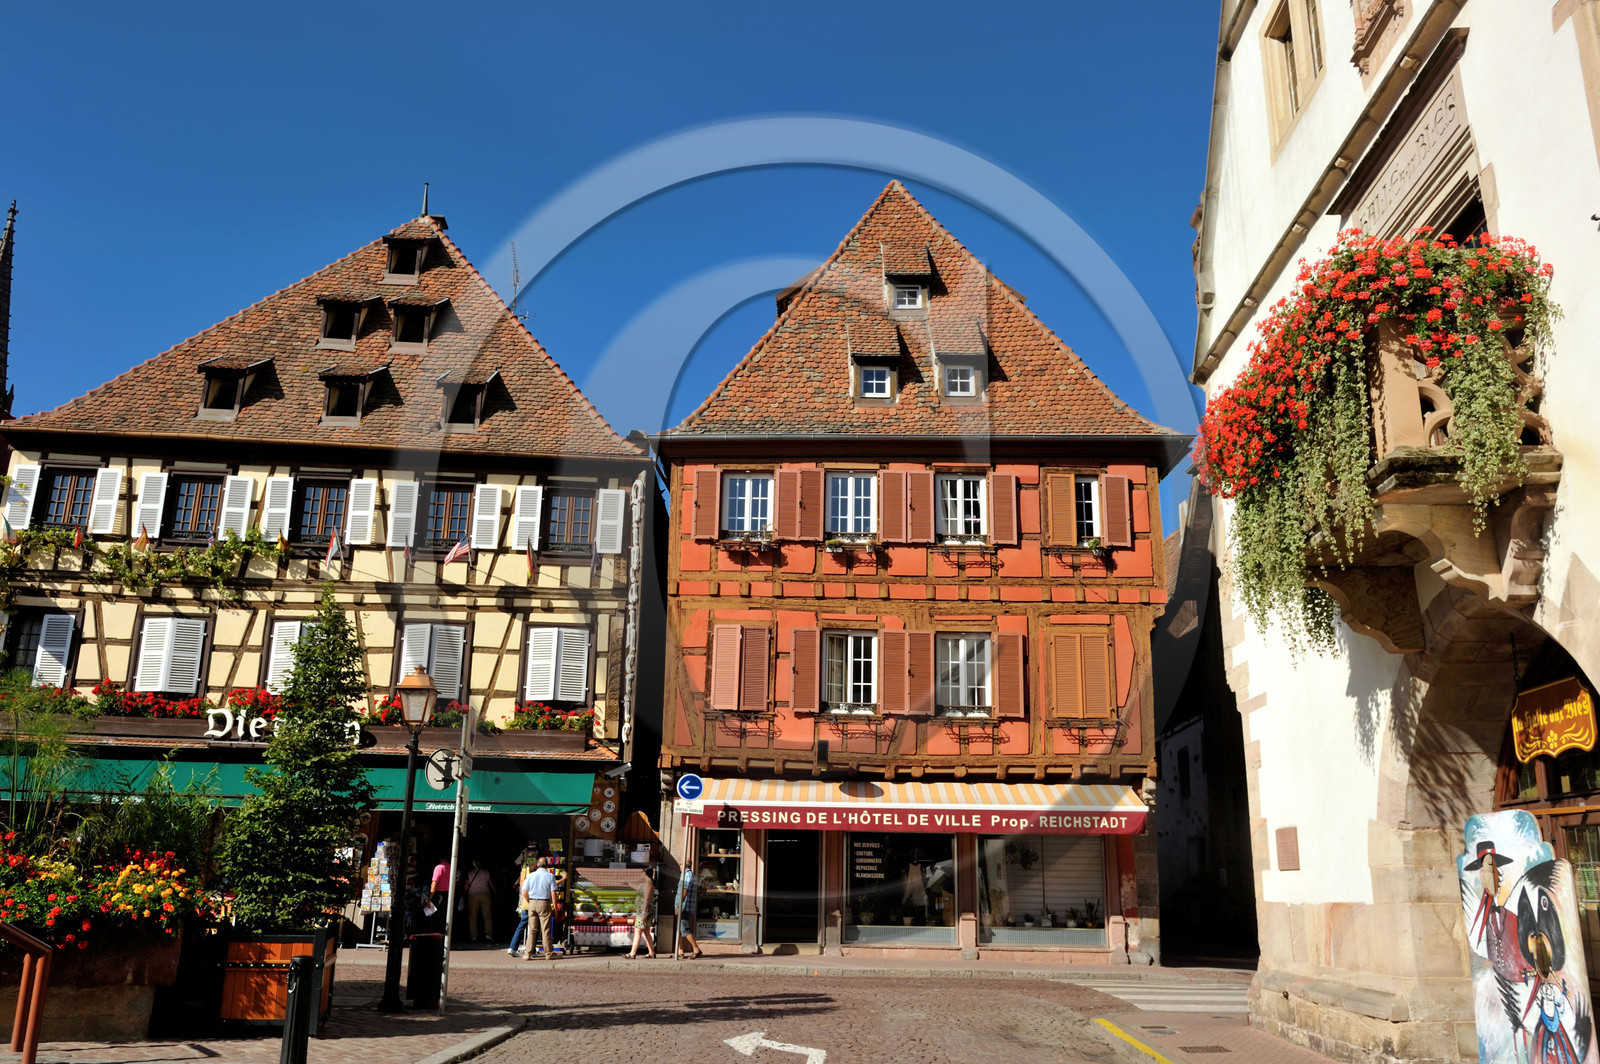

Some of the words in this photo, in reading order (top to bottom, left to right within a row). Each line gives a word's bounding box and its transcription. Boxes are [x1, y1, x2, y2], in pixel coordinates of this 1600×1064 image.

[425, 802, 455, 810] Dietrich
[717, 810, 801, 824] PRESSING
[806, 812, 828, 824] DE
[833, 810, 903, 825] L'HÔTEL
[907, 813, 929, 825] DE
[934, 814, 982, 827] VILLE
[991, 815, 1034, 830] Prop.
[1039, 815, 1128, 828] REICHSTADT
